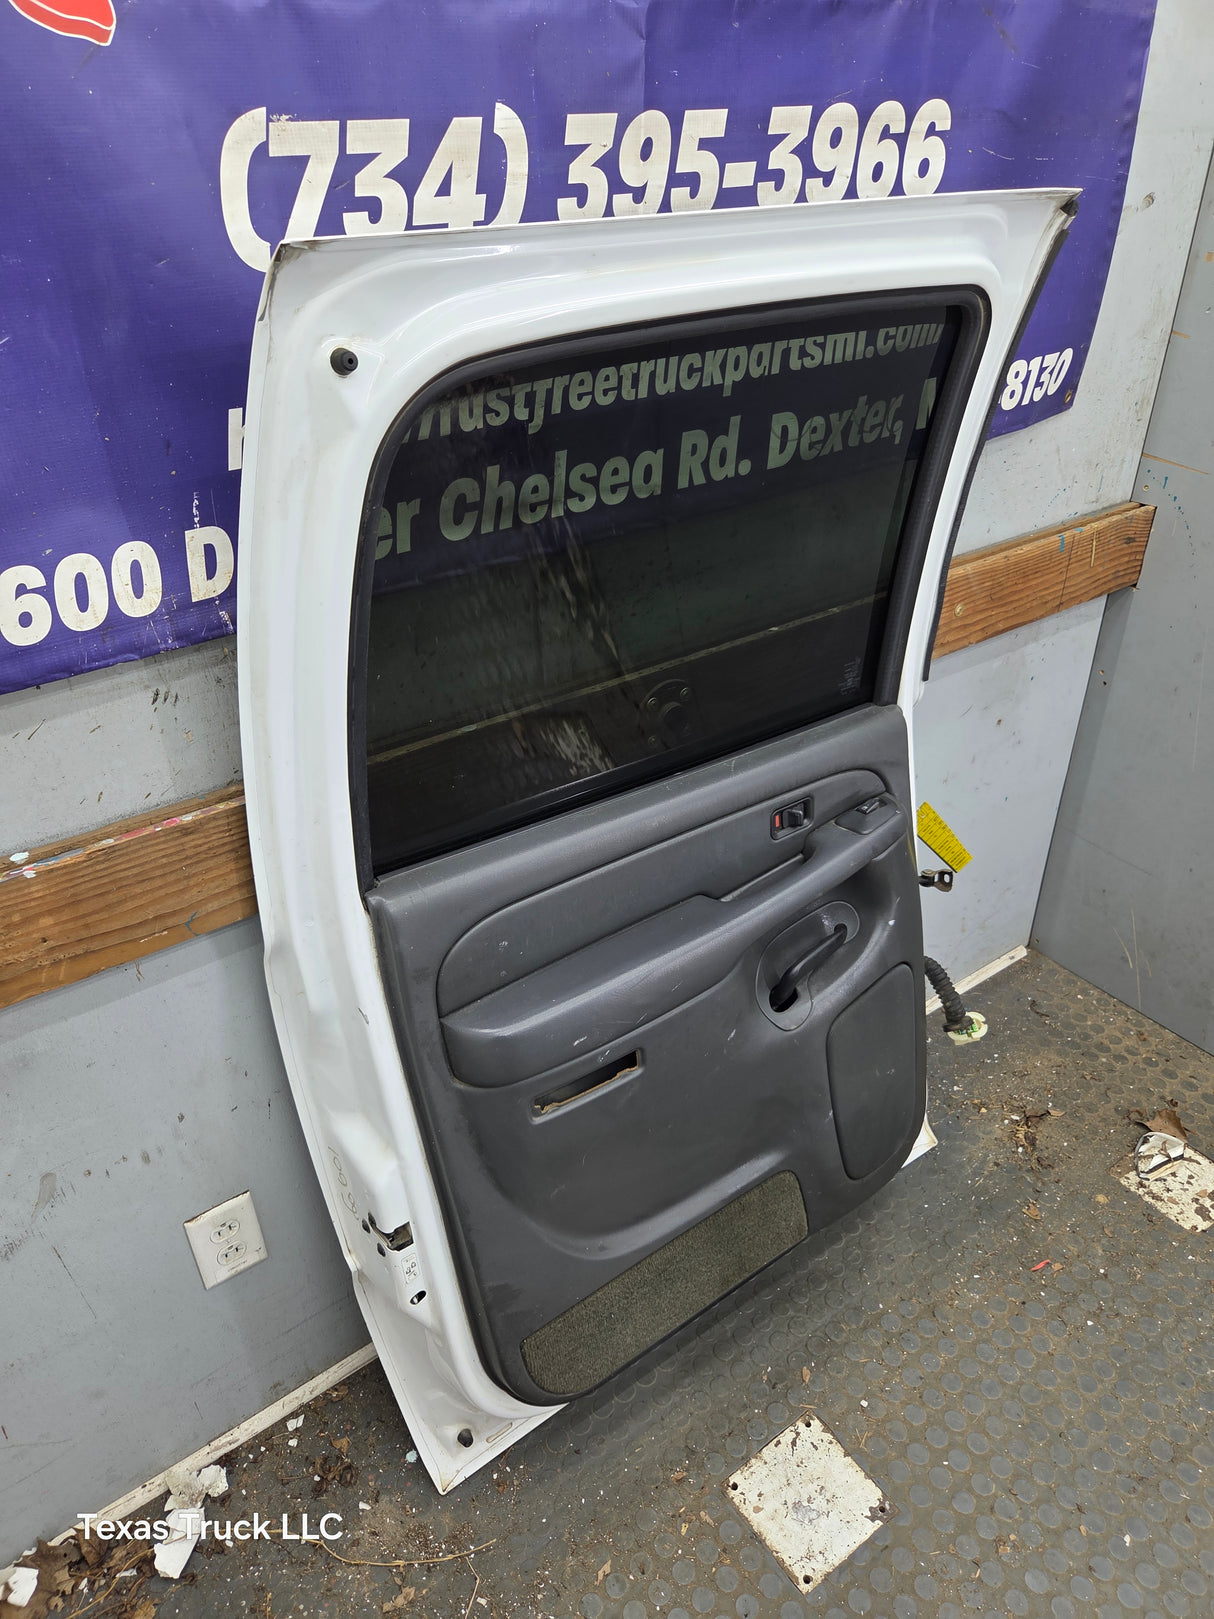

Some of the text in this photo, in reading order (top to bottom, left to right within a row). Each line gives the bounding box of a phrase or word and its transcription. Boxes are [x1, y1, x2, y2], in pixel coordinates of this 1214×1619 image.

[220, 98, 952, 273] (734) 395-3966
[438, 447, 664, 542] Chelsea
[677, 415, 752, 490] Rd.
[766, 395, 904, 470] Dexter,
[998, 347, 1074, 411] 8130
